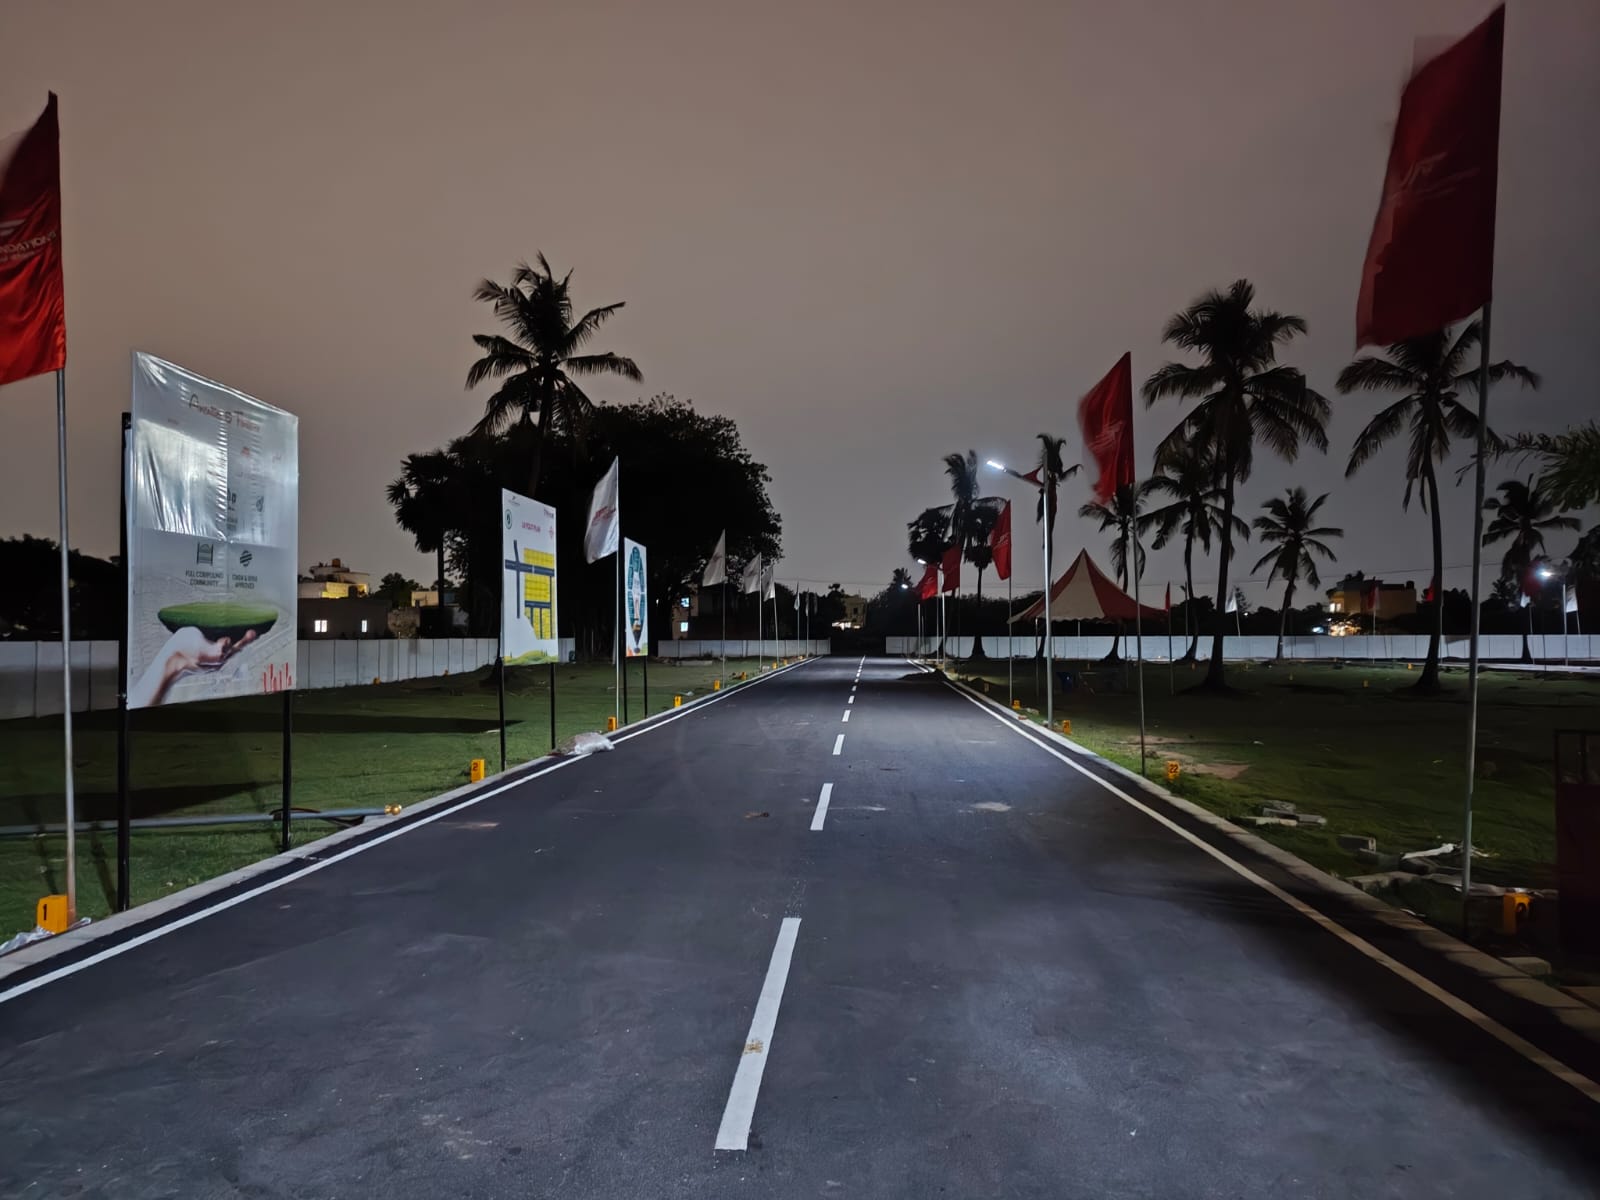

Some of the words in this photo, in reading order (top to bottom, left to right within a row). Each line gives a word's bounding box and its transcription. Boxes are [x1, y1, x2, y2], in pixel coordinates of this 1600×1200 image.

[473, 762, 479, 771] 2
[1169, 764, 1179, 773] 2
[43, 903, 48, 921] 1
